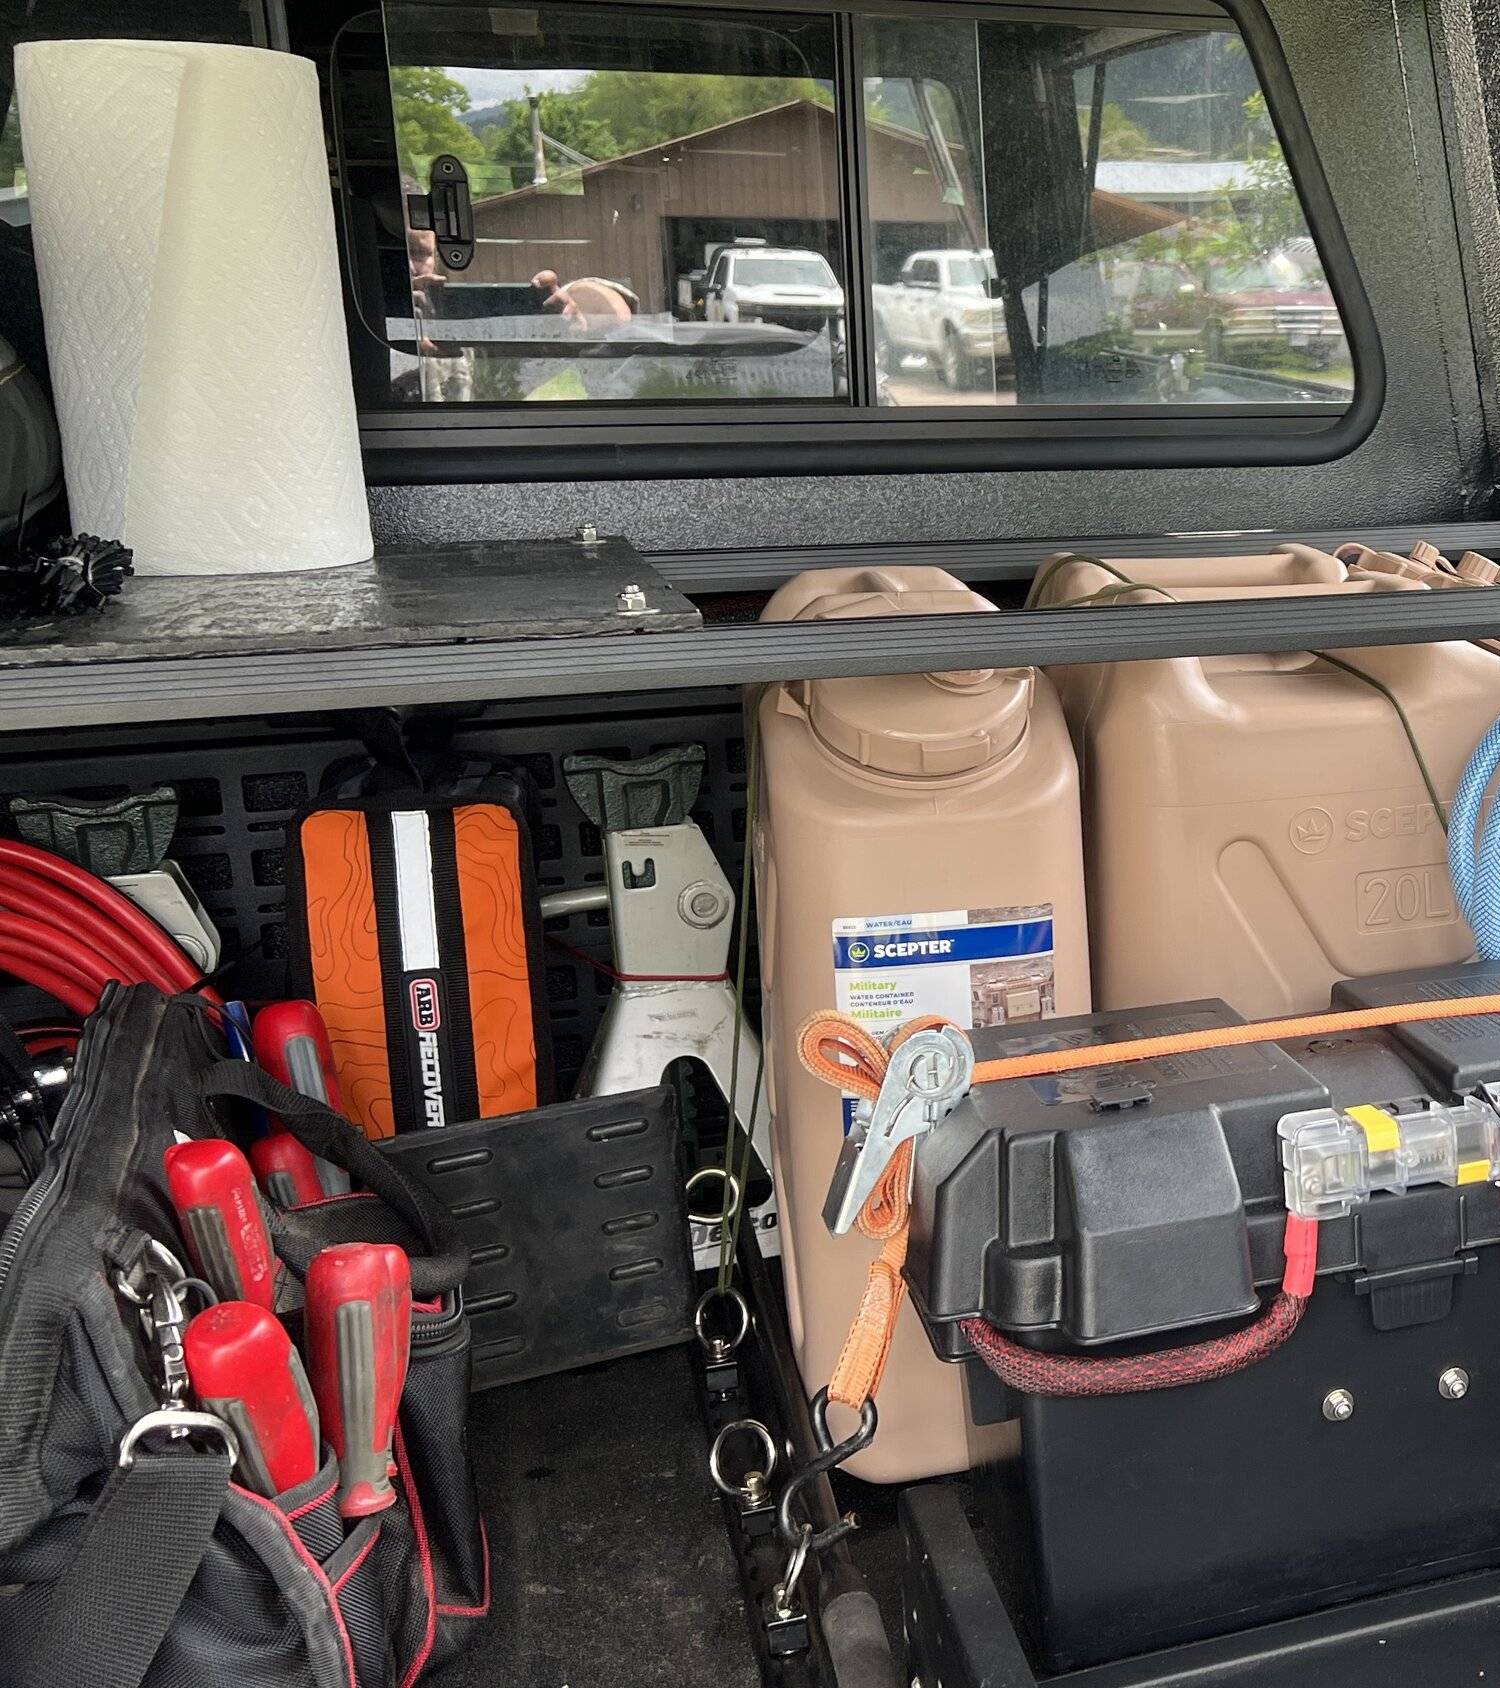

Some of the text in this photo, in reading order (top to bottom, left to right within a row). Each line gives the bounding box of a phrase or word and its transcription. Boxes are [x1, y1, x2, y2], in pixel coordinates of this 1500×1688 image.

[1344, 801, 1452, 842] SCEP
[1364, 871, 1450, 926] 20L
[865, 919, 912, 928] WATER/EAU
[874, 940, 951, 958] SCEPTER
[849, 981, 897, 991] Military
[851, 1008, 902, 1018] Militaire
[416, 986, 446, 1127] ARB RECOVER
